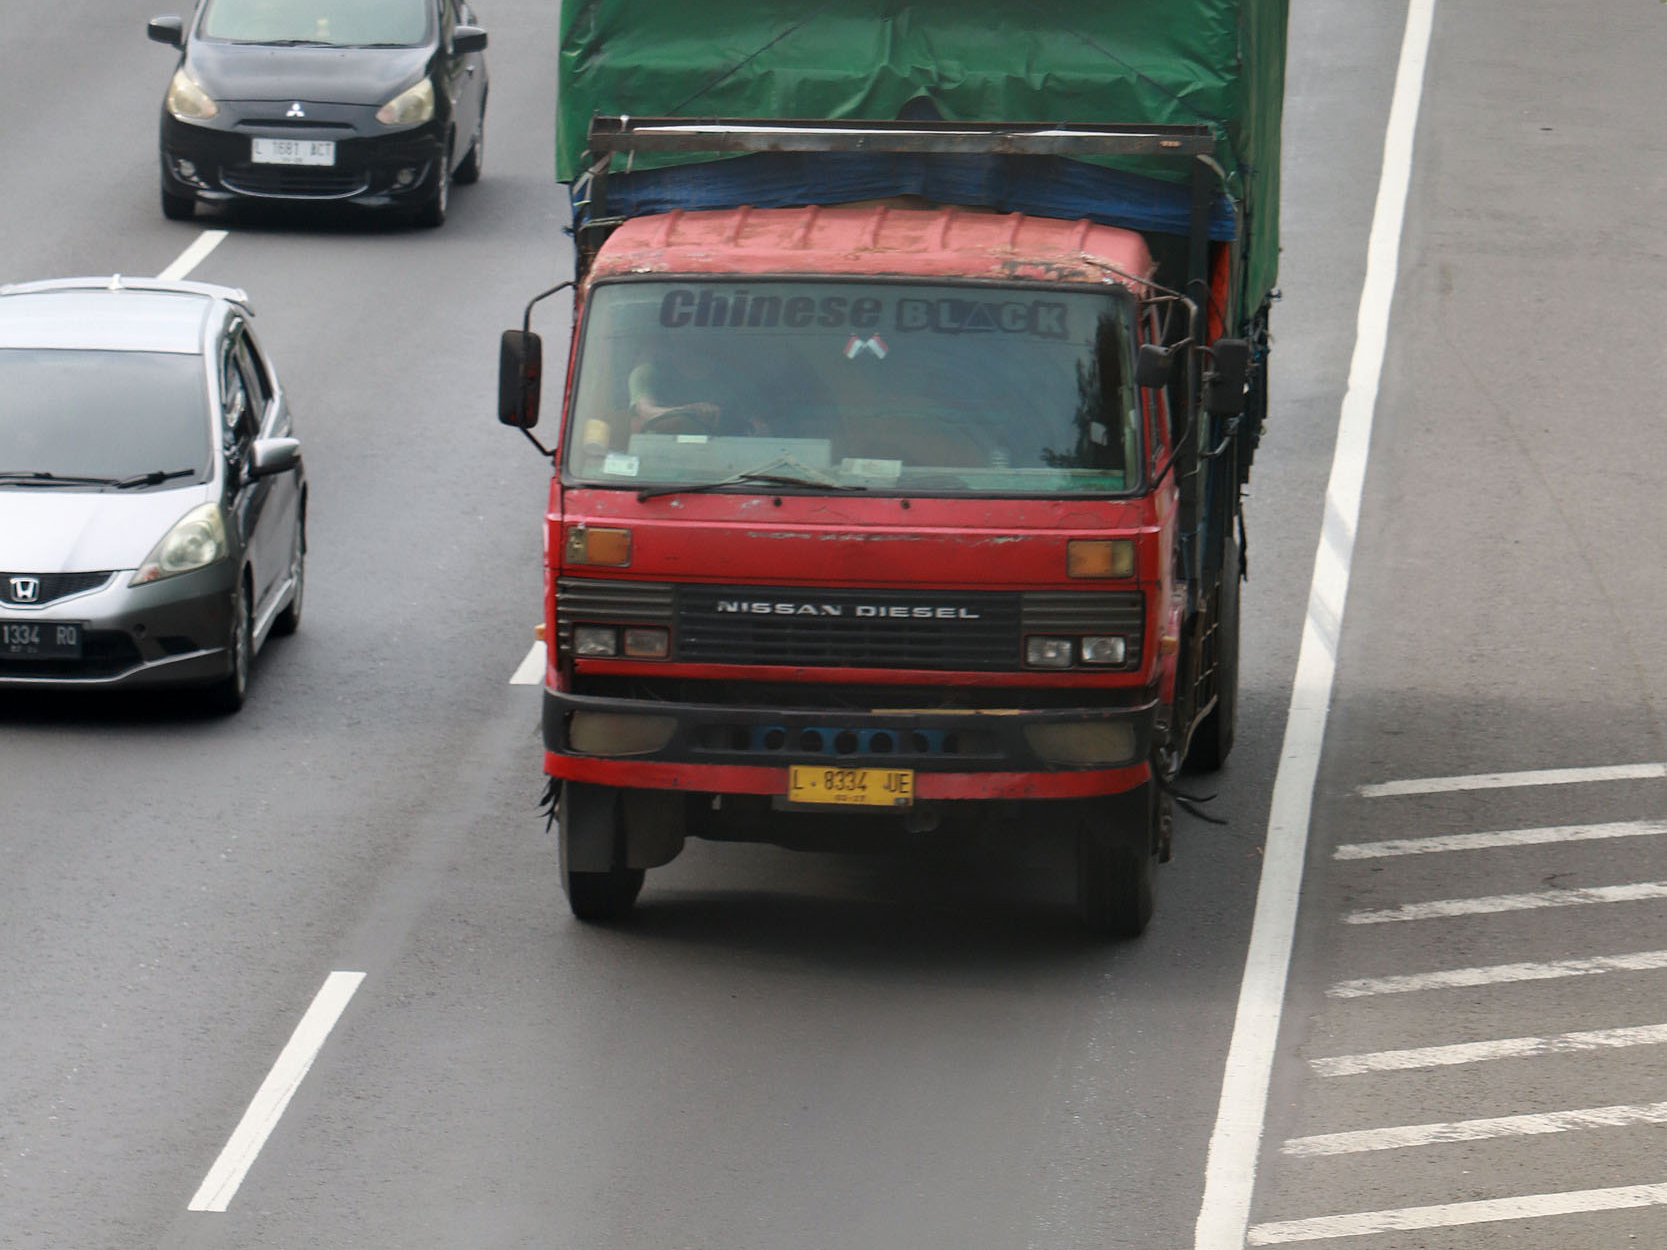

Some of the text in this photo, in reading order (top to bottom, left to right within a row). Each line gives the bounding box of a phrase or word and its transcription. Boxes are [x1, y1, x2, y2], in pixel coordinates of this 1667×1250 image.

[659, 289, 883, 329] Chinese
[717, 600, 980, 619] NISSAN DIESEL
[2, 625, 40, 645] 1334
[793, 769, 804, 790] L
[823, 770, 867, 791] 8334
